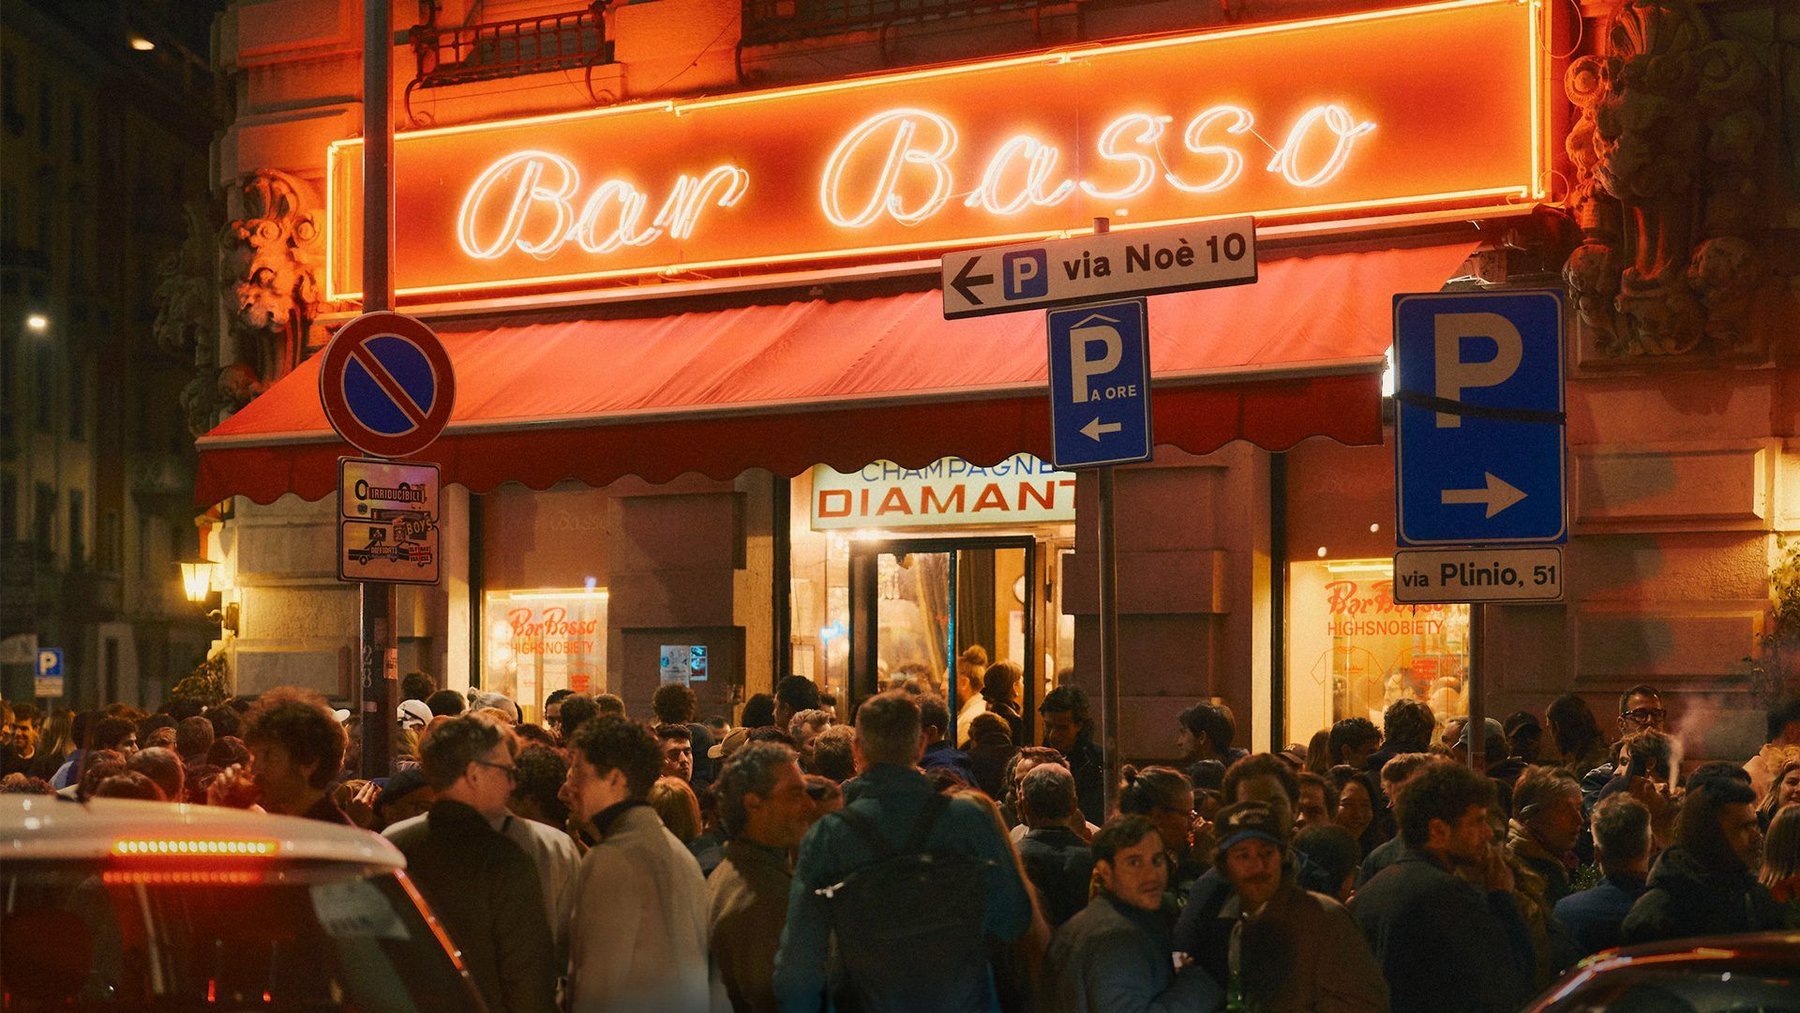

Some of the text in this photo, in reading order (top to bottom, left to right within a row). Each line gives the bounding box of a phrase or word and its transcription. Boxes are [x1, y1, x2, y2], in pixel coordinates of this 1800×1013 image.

[457, 104, 1376, 261] Bar Basso
[1012, 232, 1246, 293] P via Noè 10
[1069, 324, 1123, 403] P
[1434, 312, 1523, 428] P
[1091, 385, 1137, 401] A ORE
[406, 518, 433, 535] BOYS
[1402, 562, 1556, 588] via Plinio, 51
[1325, 580, 1374, 618] Bar
[508, 607, 597, 639] Bar Basso
[1327, 620, 1444, 636] HIGHSNOBIETY
[511, 640, 594, 655] HIGHSNOBIETY
